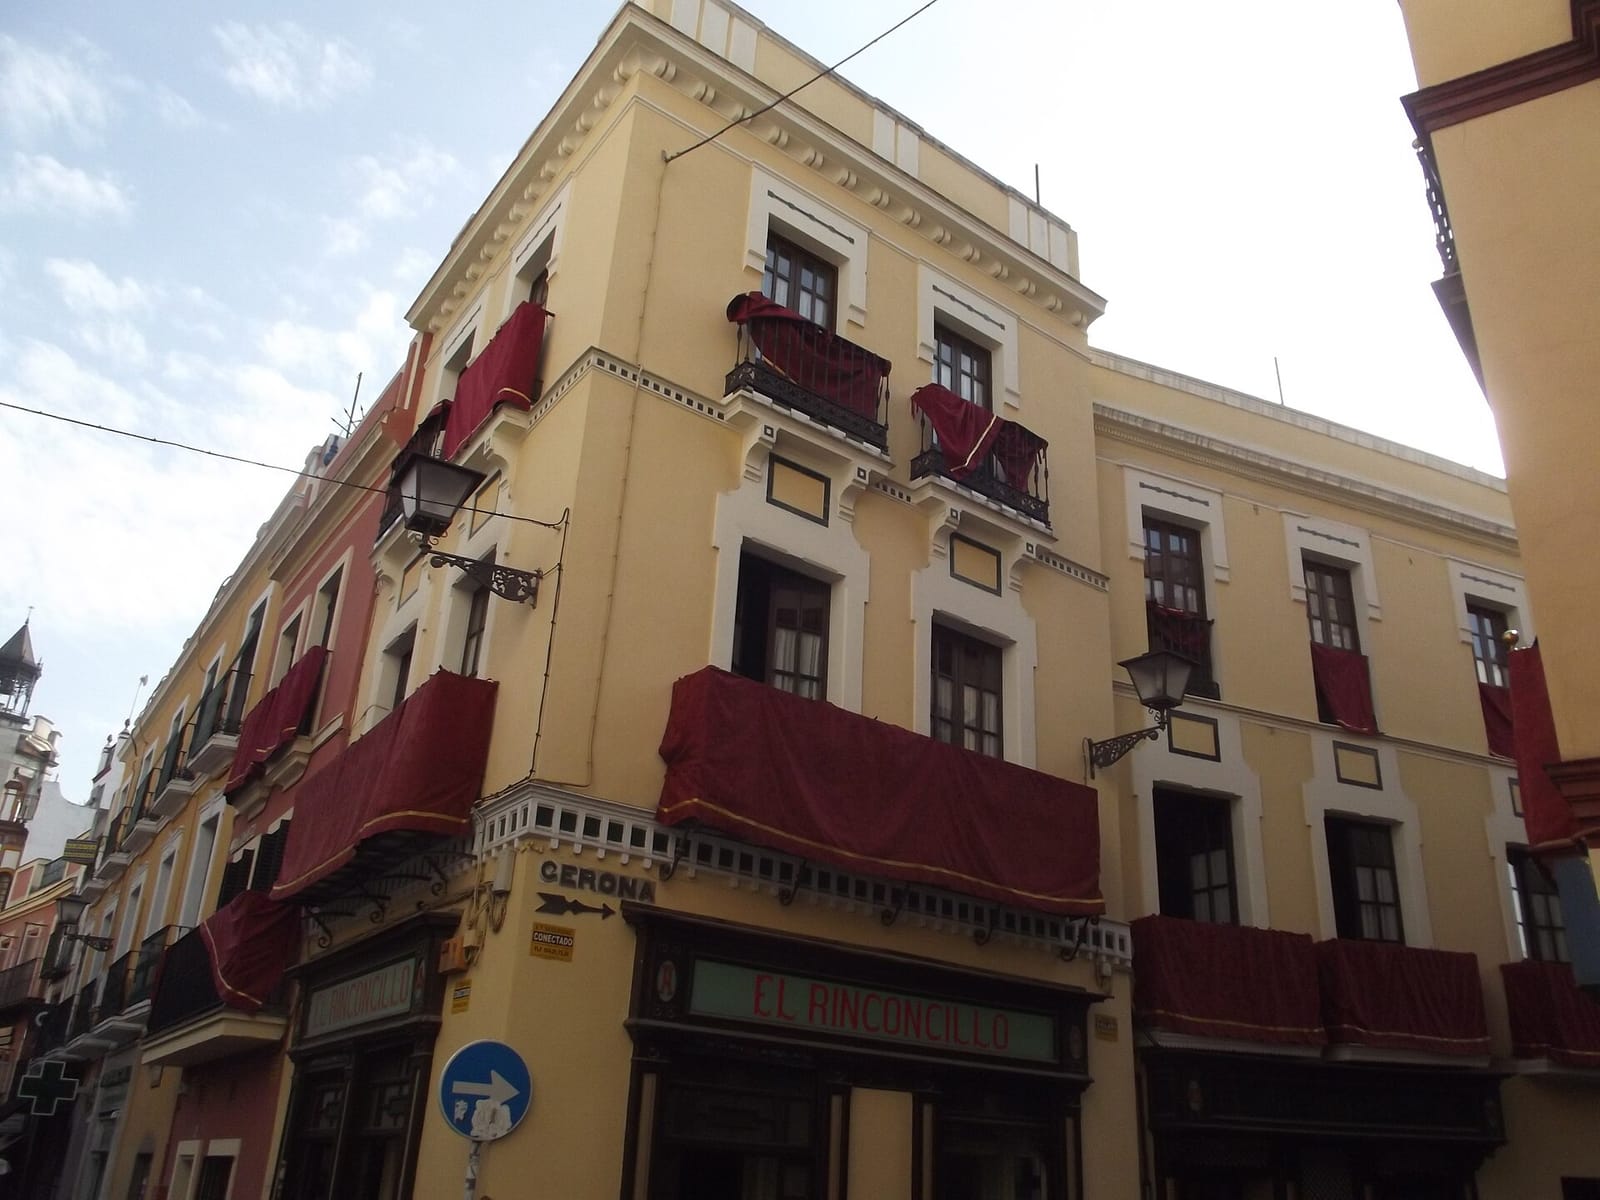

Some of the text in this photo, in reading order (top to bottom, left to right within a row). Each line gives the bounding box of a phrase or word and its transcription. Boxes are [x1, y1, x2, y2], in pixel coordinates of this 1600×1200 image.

[541, 860, 656, 904] GERONA
[533, 932, 573, 946] CONECTADO
[331, 965, 410, 1021] RINCONCILLO
[753, 974, 1009, 1050] EL RINCONCILLO
